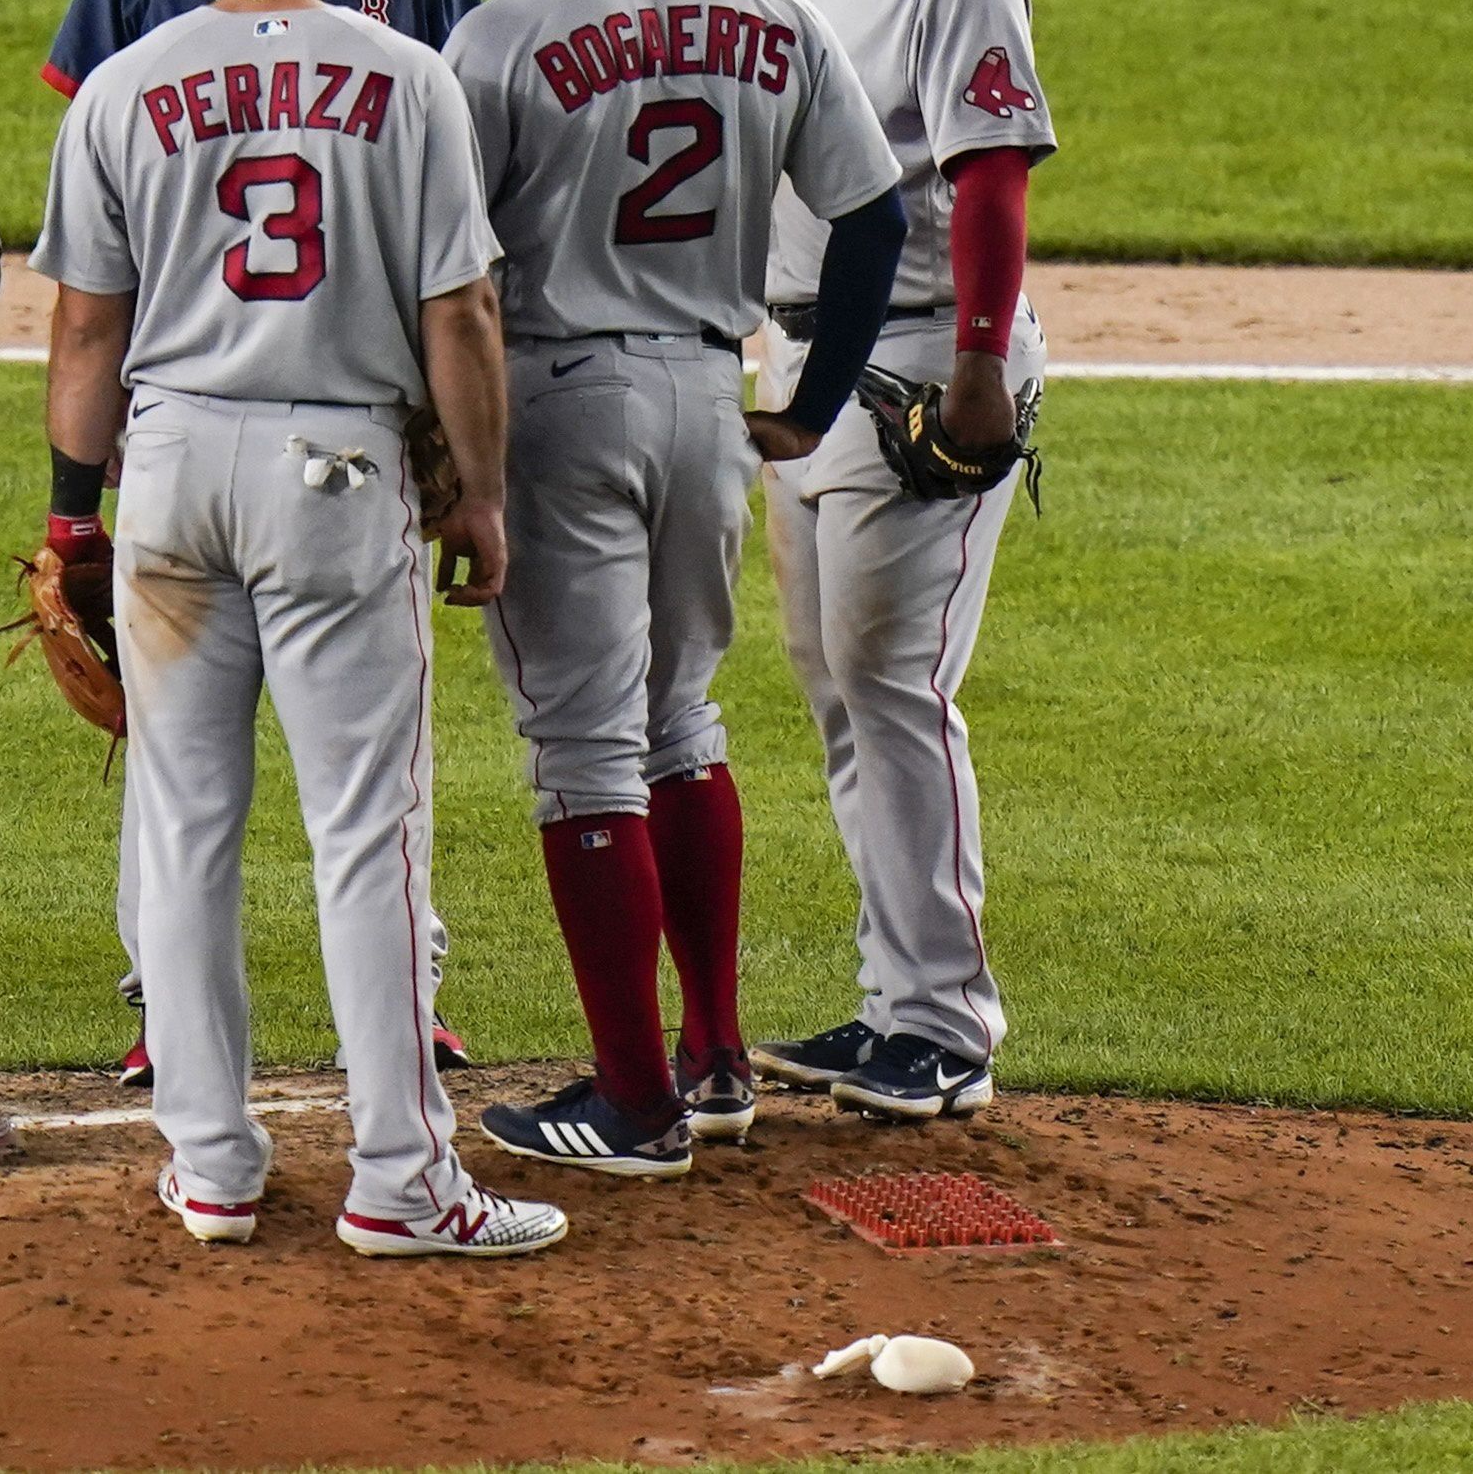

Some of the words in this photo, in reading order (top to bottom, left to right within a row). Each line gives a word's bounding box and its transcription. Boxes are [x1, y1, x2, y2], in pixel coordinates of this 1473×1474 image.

[142, 60, 394, 156] PERAZA
[534, 4, 797, 114] BOGAERTS
[216, 153, 326, 302] 3
[614, 98, 724, 245] 2
